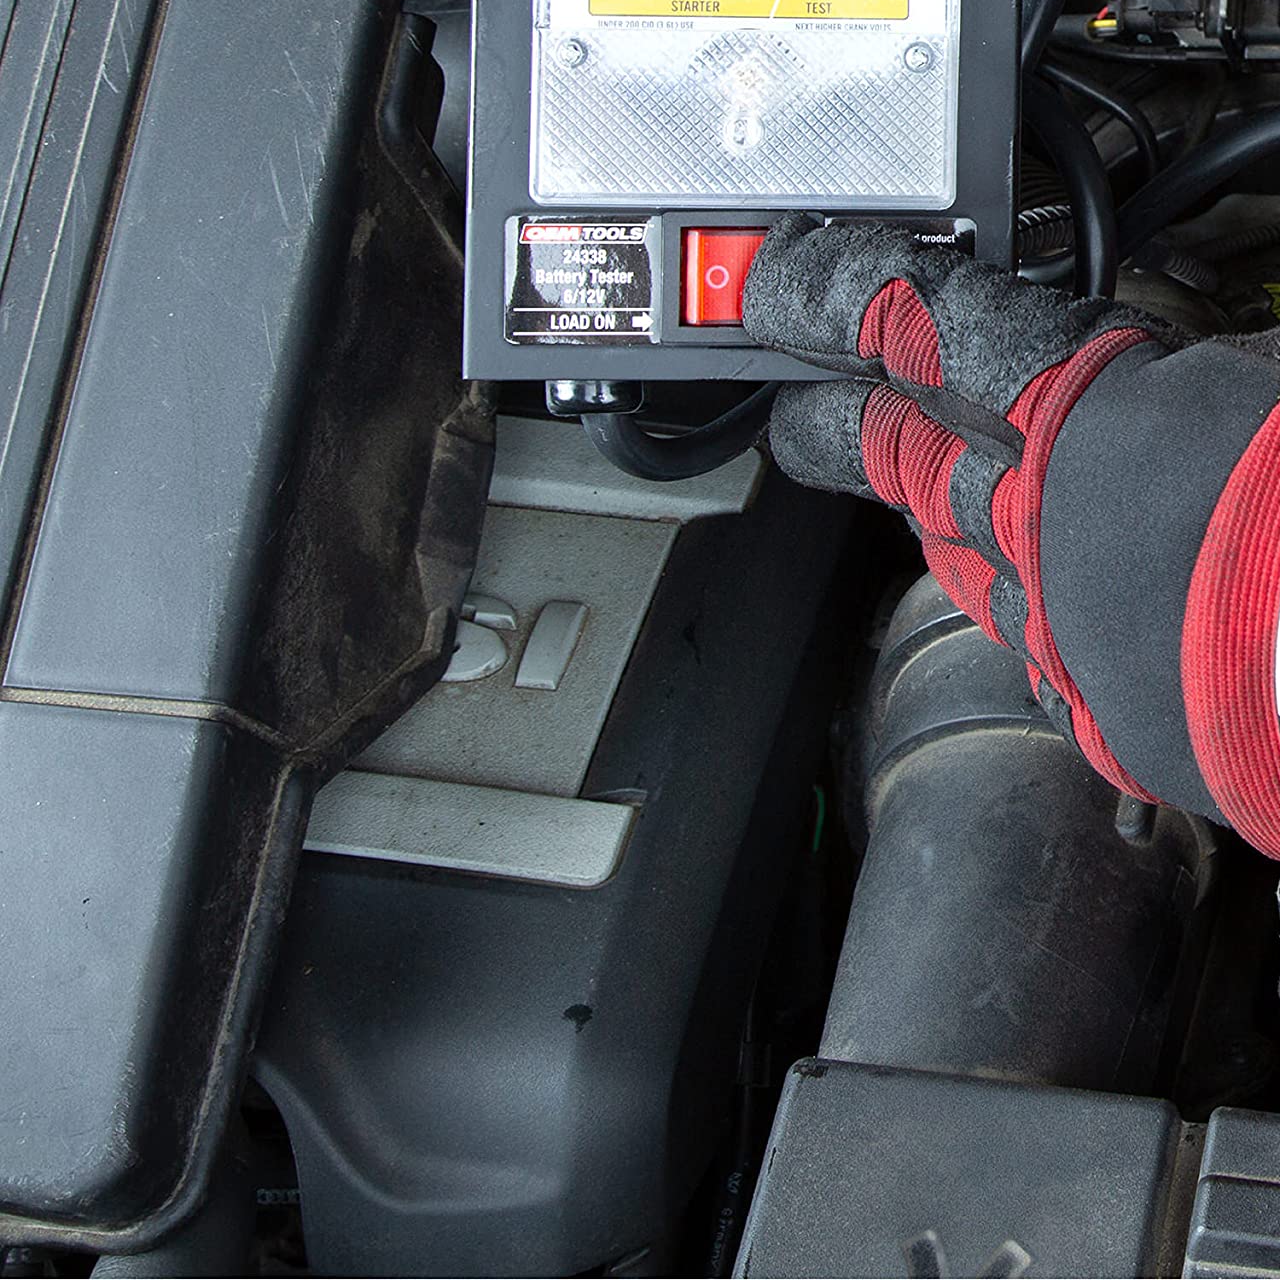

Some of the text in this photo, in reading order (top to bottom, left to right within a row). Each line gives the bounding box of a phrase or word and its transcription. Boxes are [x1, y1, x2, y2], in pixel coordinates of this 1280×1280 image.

[671, 0, 832, 14] STARTER TEST
[563, 250, 607, 265] 24338
[536, 269, 634, 286] Battery Tester
[563, 289, 606, 304] 6/12V
[550, 314, 616, 330] LOAD ON
